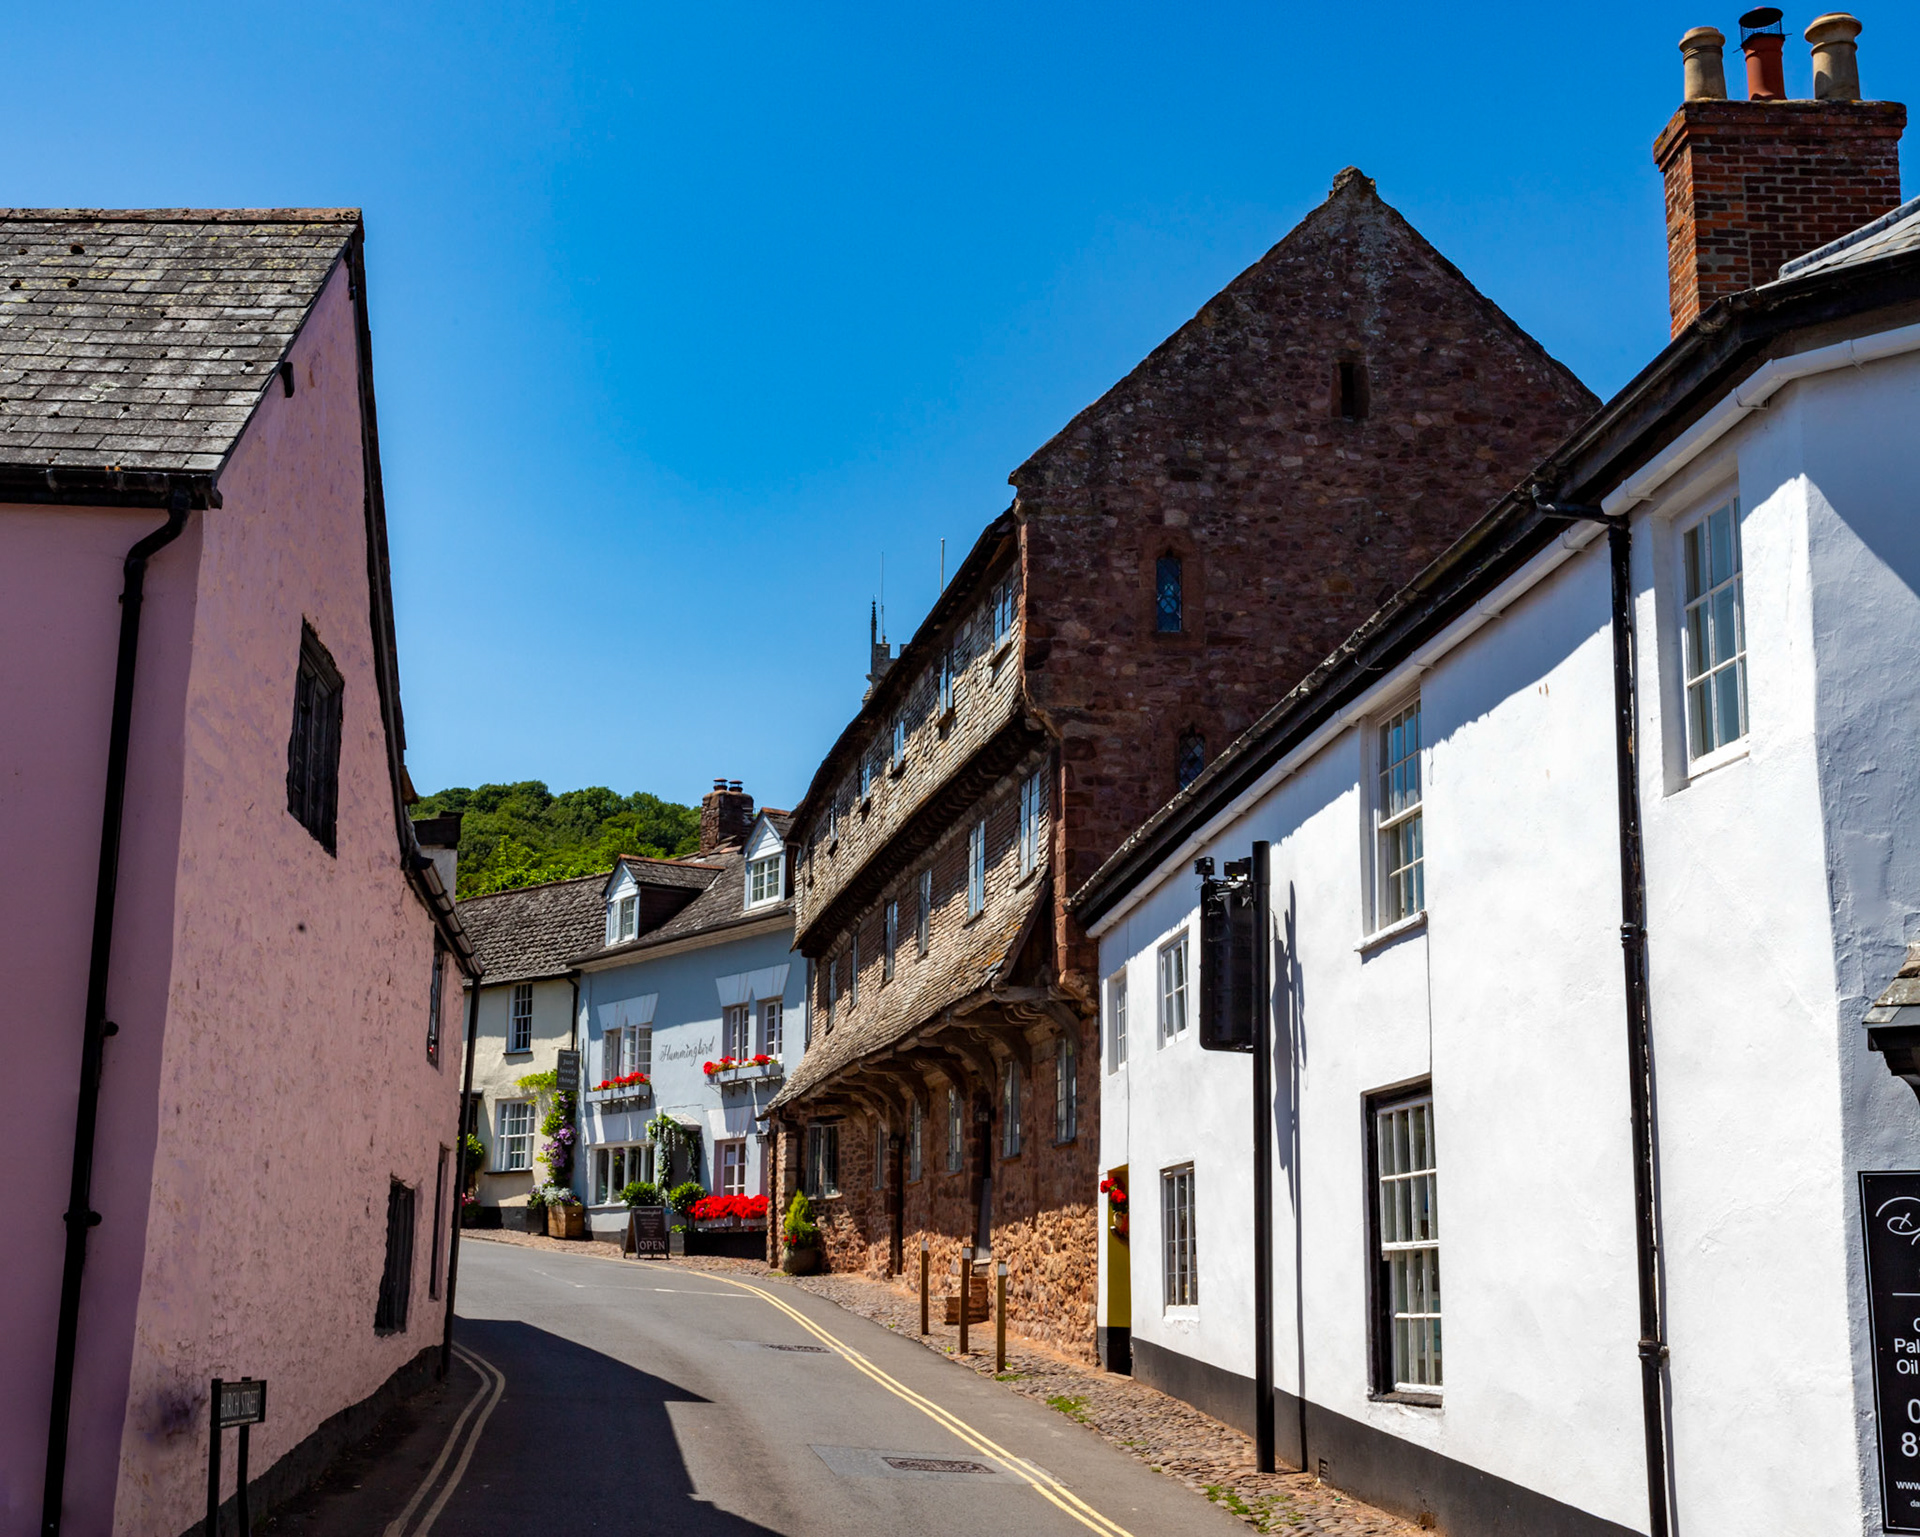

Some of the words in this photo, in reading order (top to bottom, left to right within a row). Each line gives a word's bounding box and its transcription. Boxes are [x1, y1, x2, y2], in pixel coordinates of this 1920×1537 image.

[659, 1036, 715, 1067] Hummingbird
[639, 1240, 666, 1250] OPEN
[1896, 1358, 1919, 1375] Oil
[220, 1392, 240, 1419] HURCH
